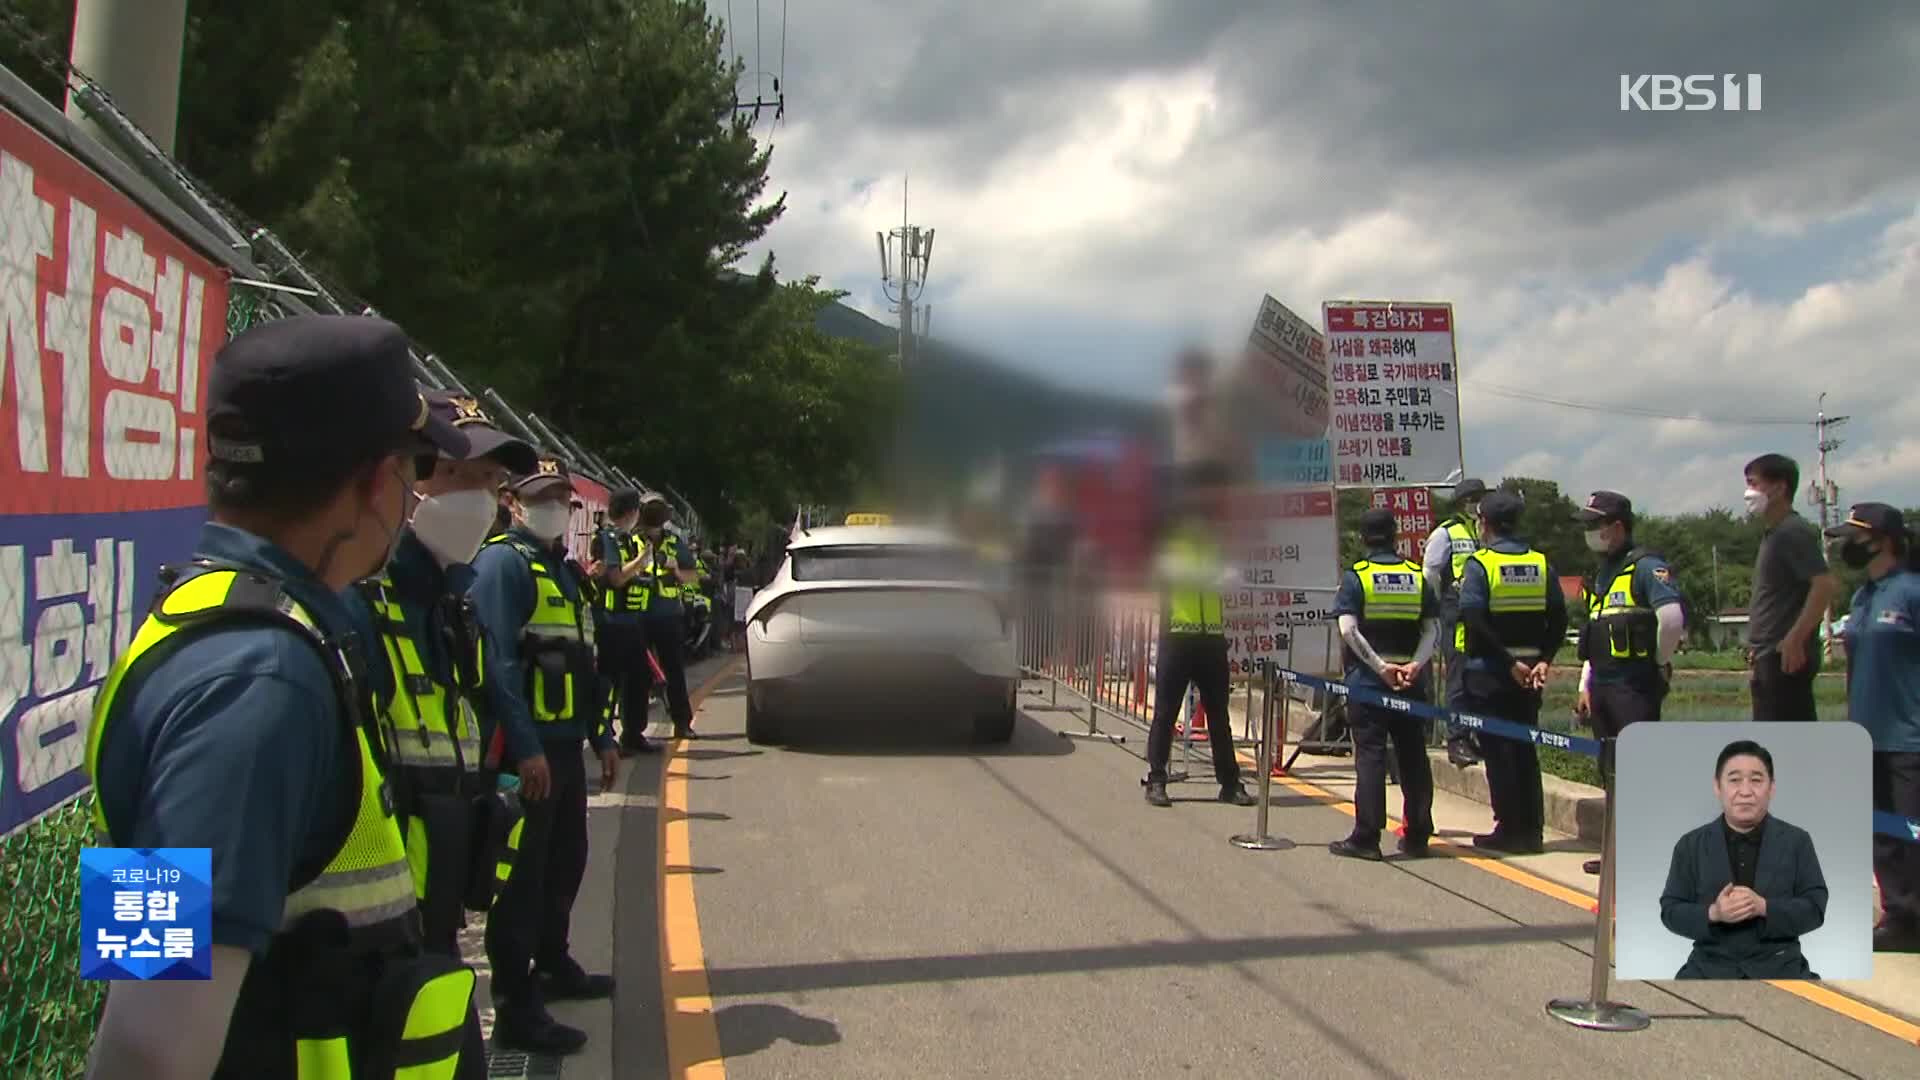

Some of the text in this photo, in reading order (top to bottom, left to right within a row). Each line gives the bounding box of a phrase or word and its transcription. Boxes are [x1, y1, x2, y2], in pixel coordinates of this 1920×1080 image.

[1330, 338, 1416, 358] 사실을 왜곡하여
[1383, 363, 1451, 382] 국가피해자를
[1335, 388, 1382, 406] 모욕하고
[1385, 388, 1431, 406] 주민들과
[1336, 412, 1445, 432] 이념전쟁을 부추기는
[1338, 437, 1412, 457] 쓰레기 언론을
